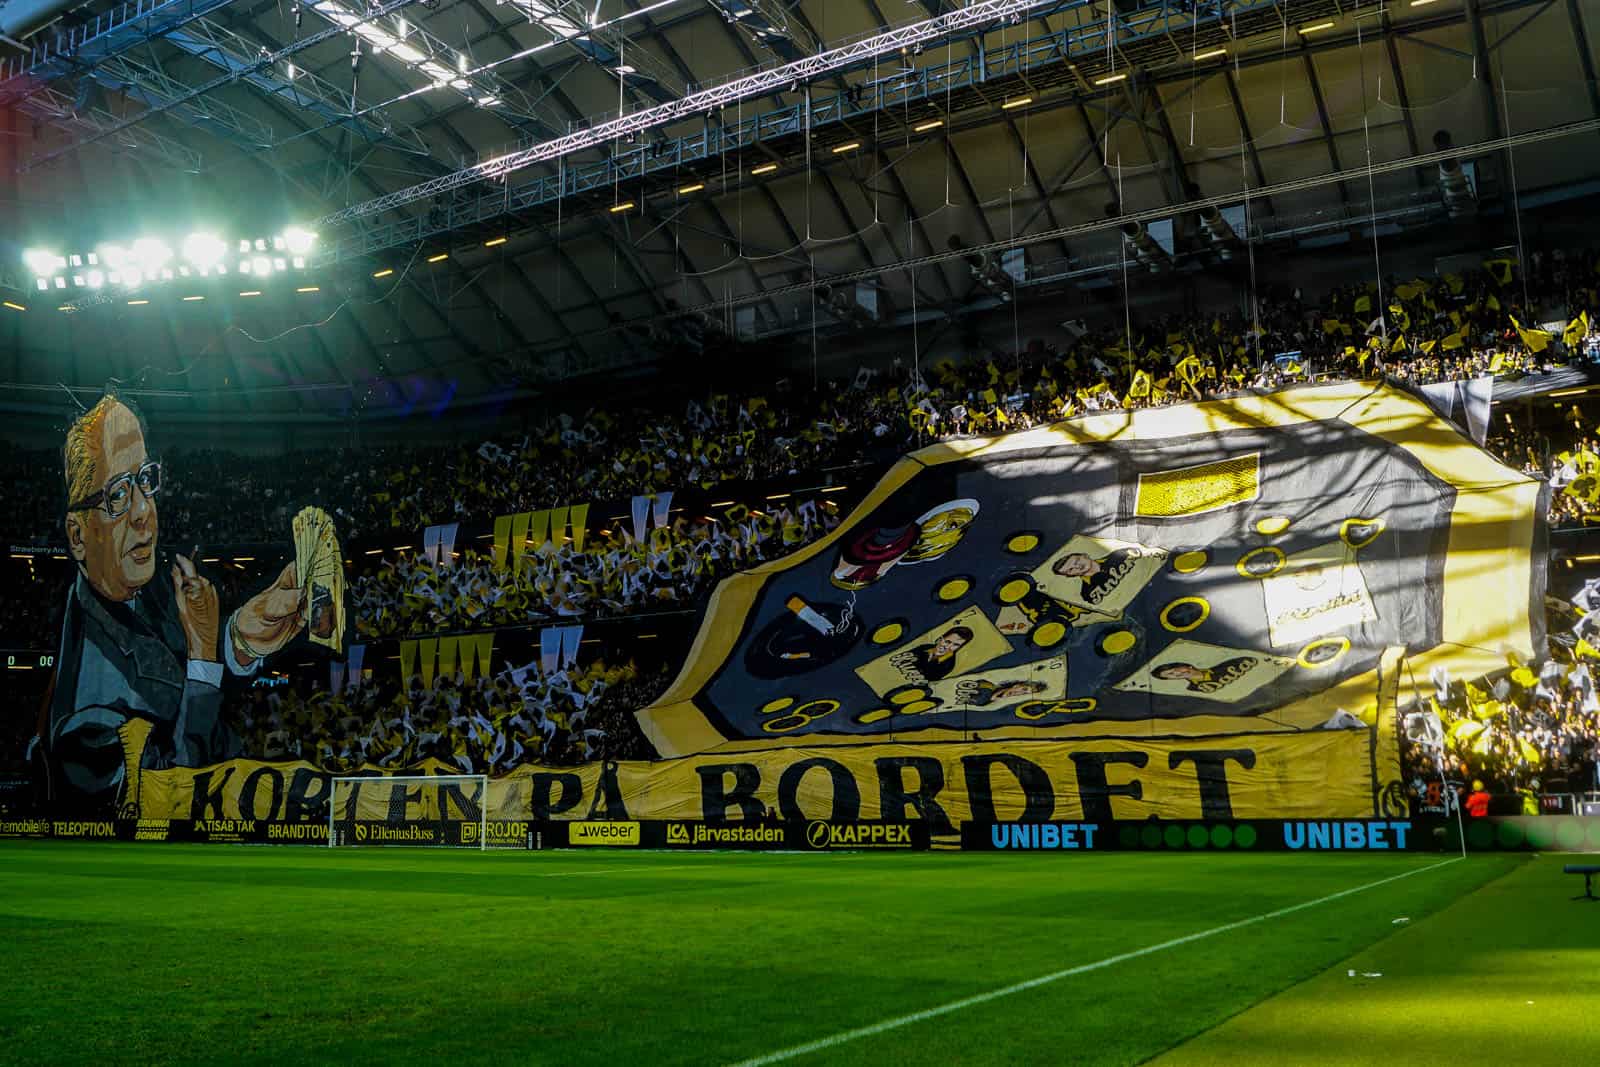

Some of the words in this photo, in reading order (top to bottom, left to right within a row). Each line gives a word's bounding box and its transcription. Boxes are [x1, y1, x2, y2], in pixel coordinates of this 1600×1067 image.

[10, 545, 50, 554] Strawberry
[205, 819, 235, 832] TISAB
[236, 819, 255, 832] TAK
[587, 824, 634, 838] weber
[667, 823, 689, 843] ICA
[692, 824, 784, 845] Järvastaden
[831, 825, 911, 843] KAPPEX
[992, 824, 1098, 848] UNIBET
[1283, 822, 1411, 849] UNIBET
